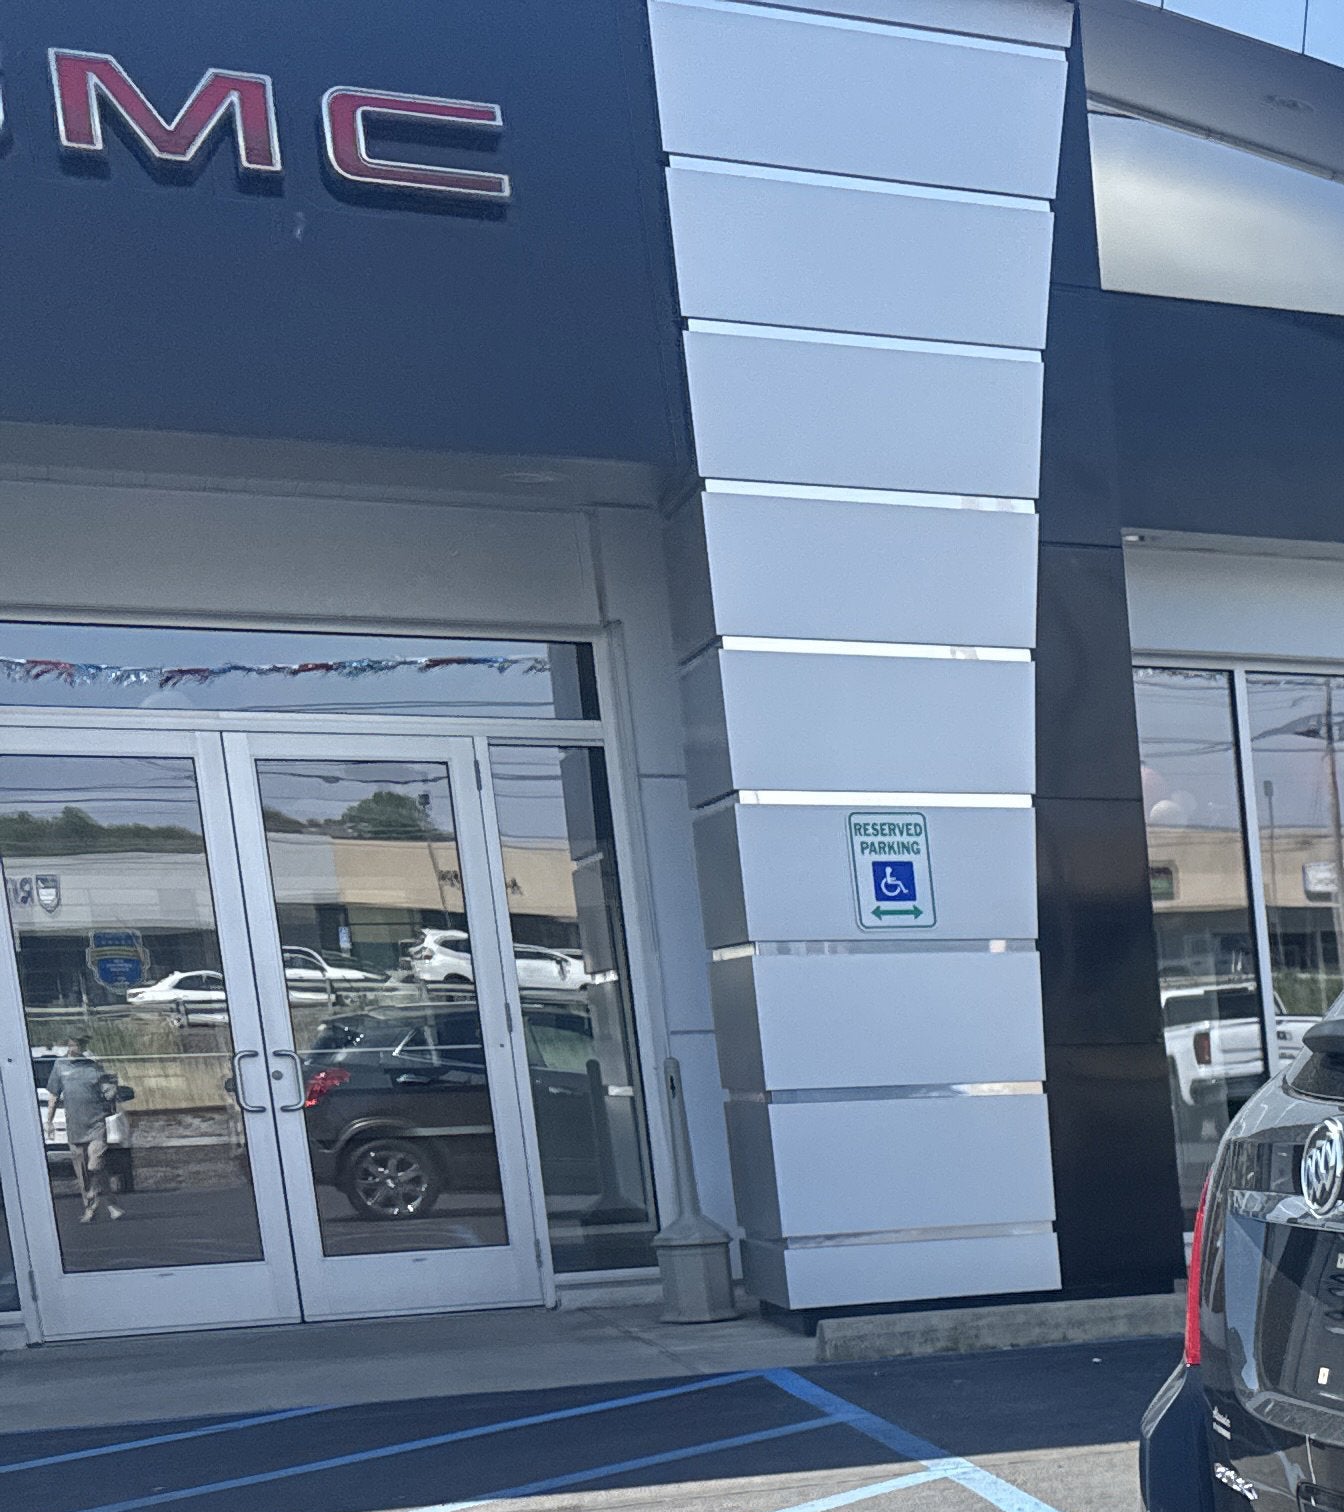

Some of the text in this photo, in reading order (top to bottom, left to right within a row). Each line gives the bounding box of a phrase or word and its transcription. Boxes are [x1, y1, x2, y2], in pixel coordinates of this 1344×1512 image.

[0, 47, 511, 198] MC
[853, 822, 923, 837] RESERVED
[860, 841, 921, 856] PARKING
